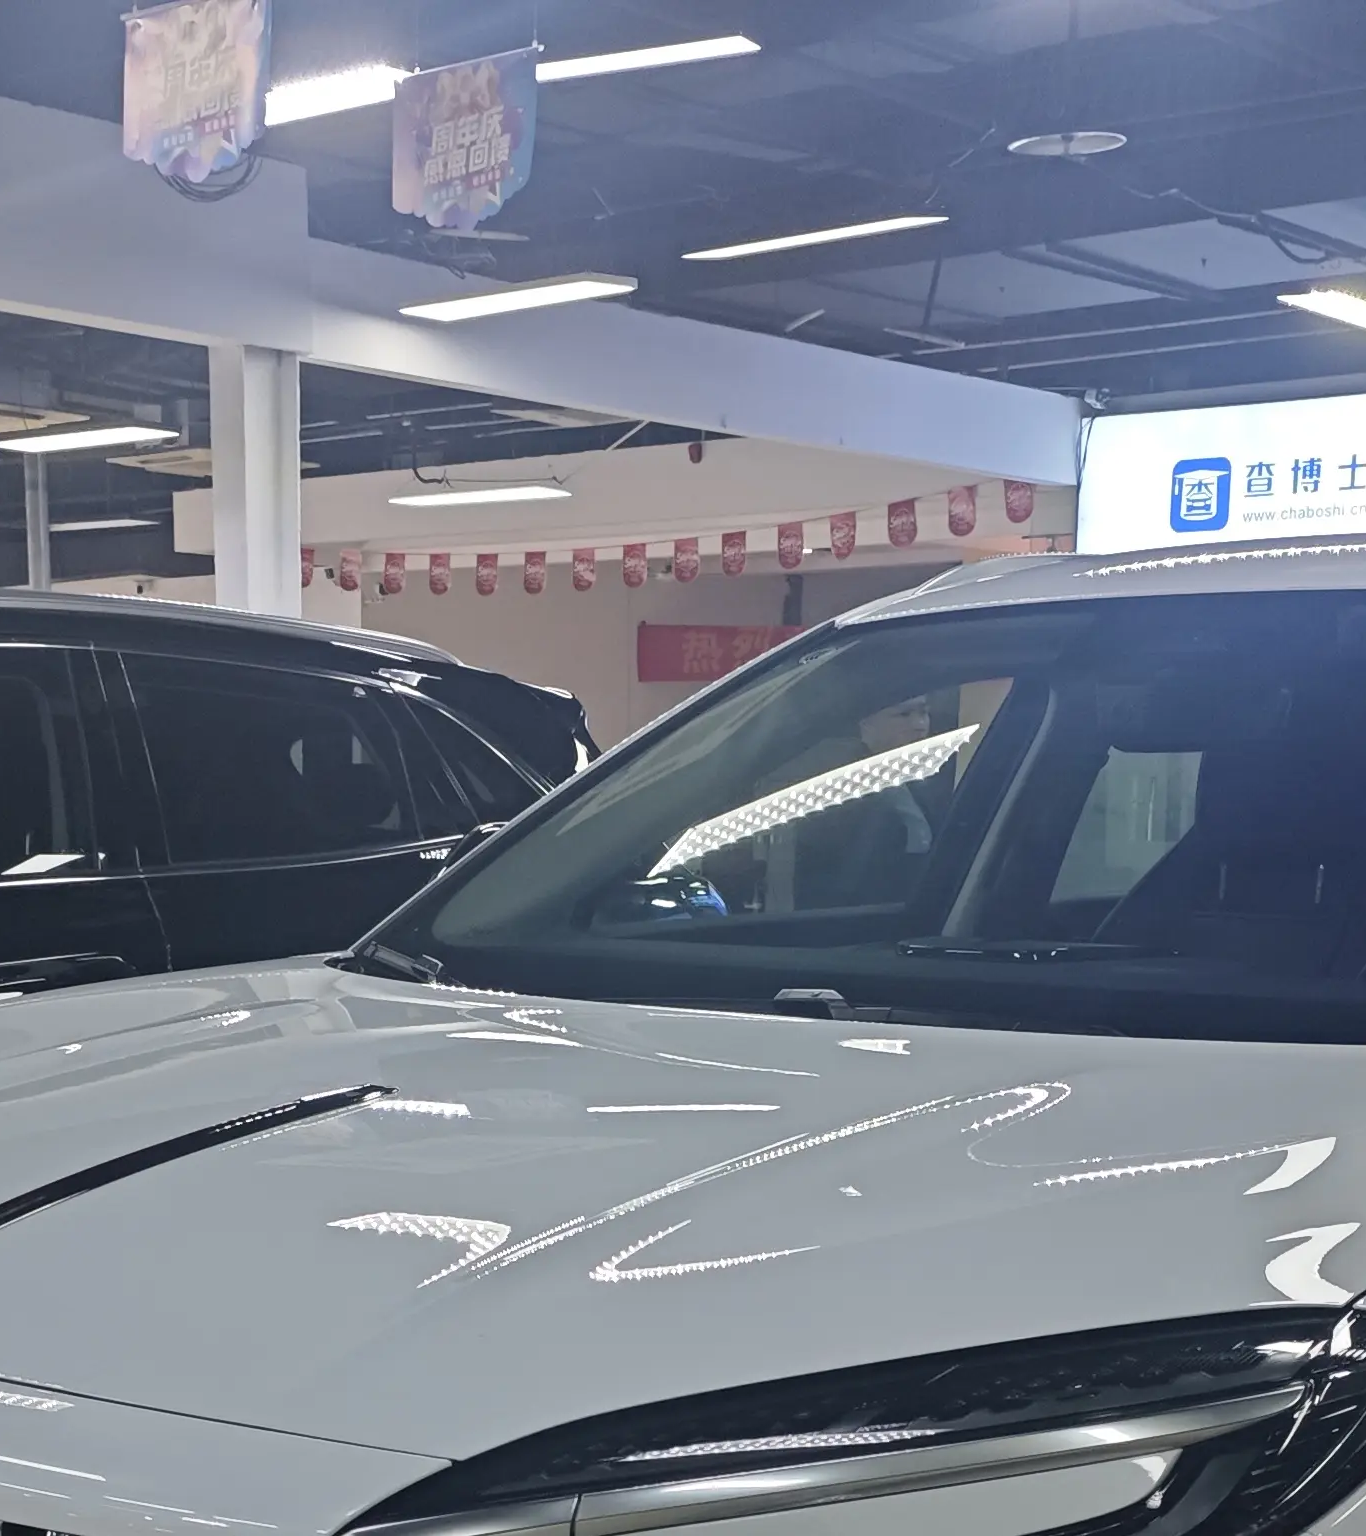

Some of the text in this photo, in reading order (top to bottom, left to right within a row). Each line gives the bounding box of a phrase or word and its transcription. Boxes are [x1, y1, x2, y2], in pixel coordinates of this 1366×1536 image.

[431, 105, 504, 156] 周年庆
[1243, 503, 1366, 523] www.chaboshi.cn
